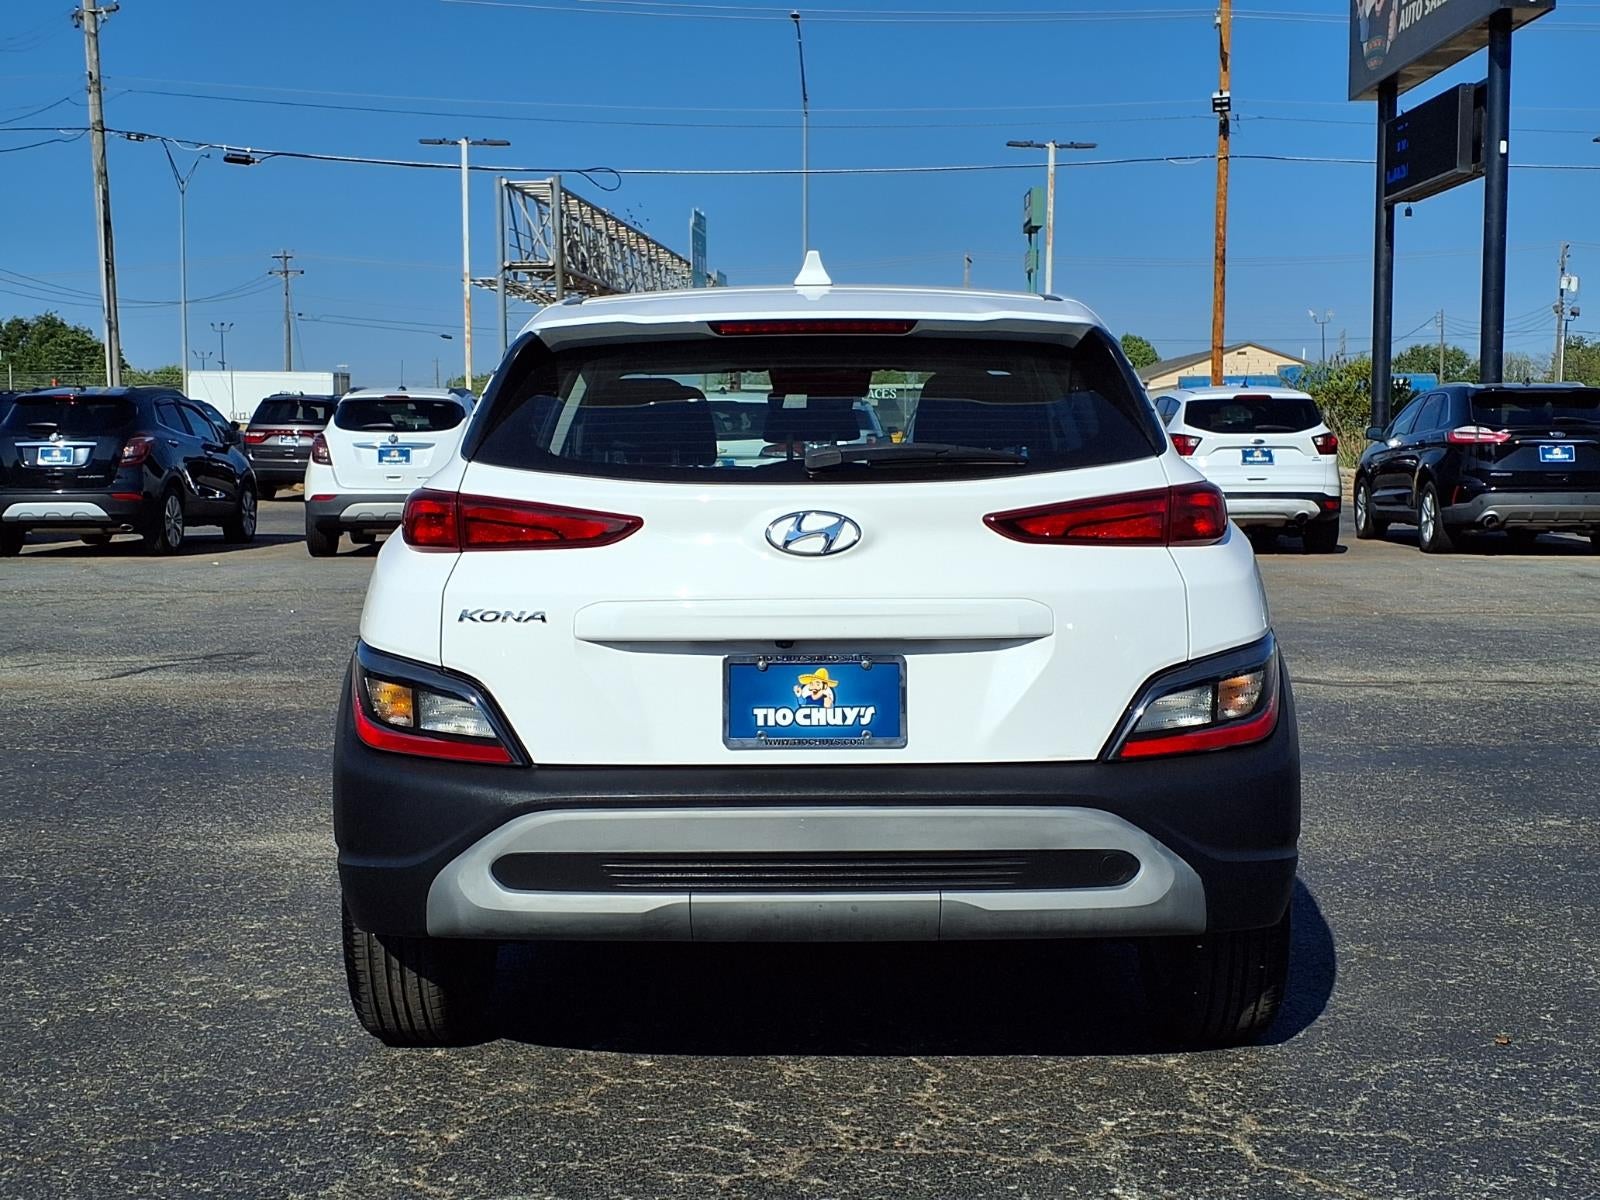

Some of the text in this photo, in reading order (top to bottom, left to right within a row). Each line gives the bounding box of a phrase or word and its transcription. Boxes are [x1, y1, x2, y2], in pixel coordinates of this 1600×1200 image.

[1398, 0, 1423, 33] AUTO
[867, 388, 897, 399] ACES
[457, 608, 547, 623] KONA
